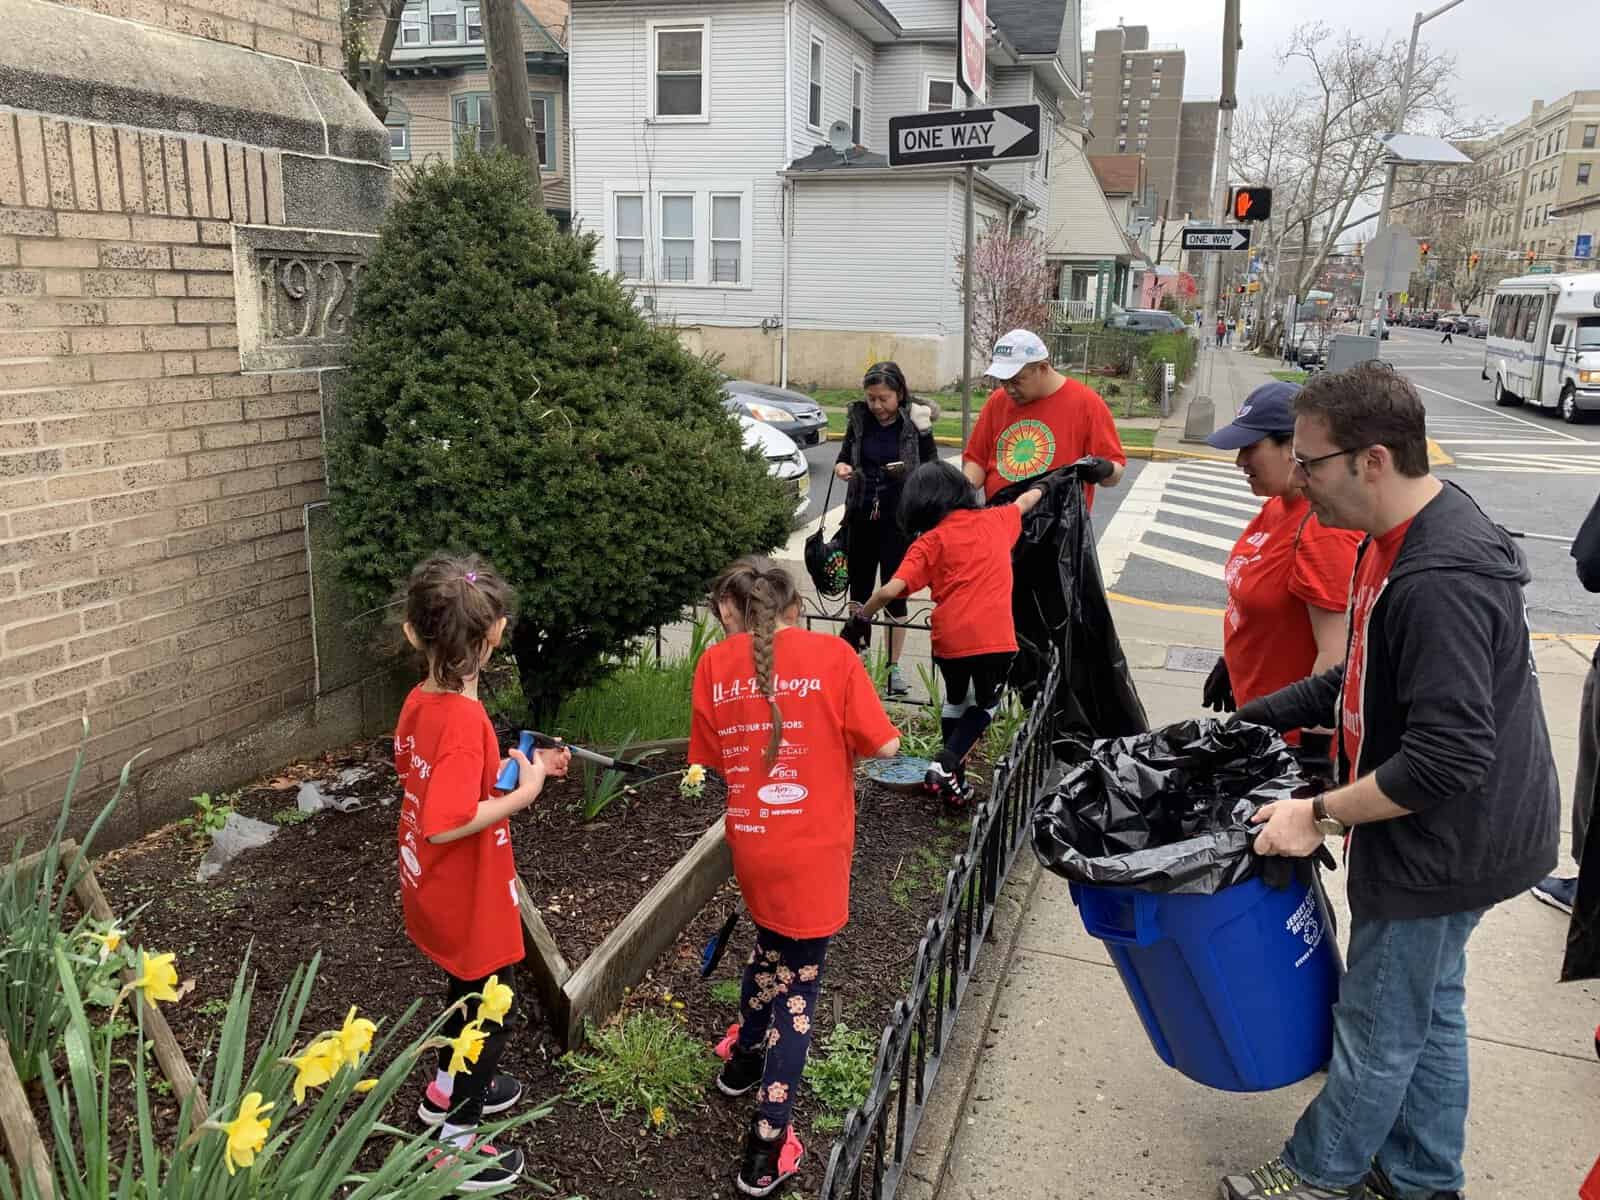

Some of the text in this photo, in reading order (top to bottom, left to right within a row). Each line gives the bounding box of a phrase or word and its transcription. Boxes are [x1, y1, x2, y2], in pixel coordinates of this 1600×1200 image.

[903, 124, 994, 150] ONE WAY
[1189, 235, 1232, 244] ONE WAY
[259, 258, 368, 338] 192
